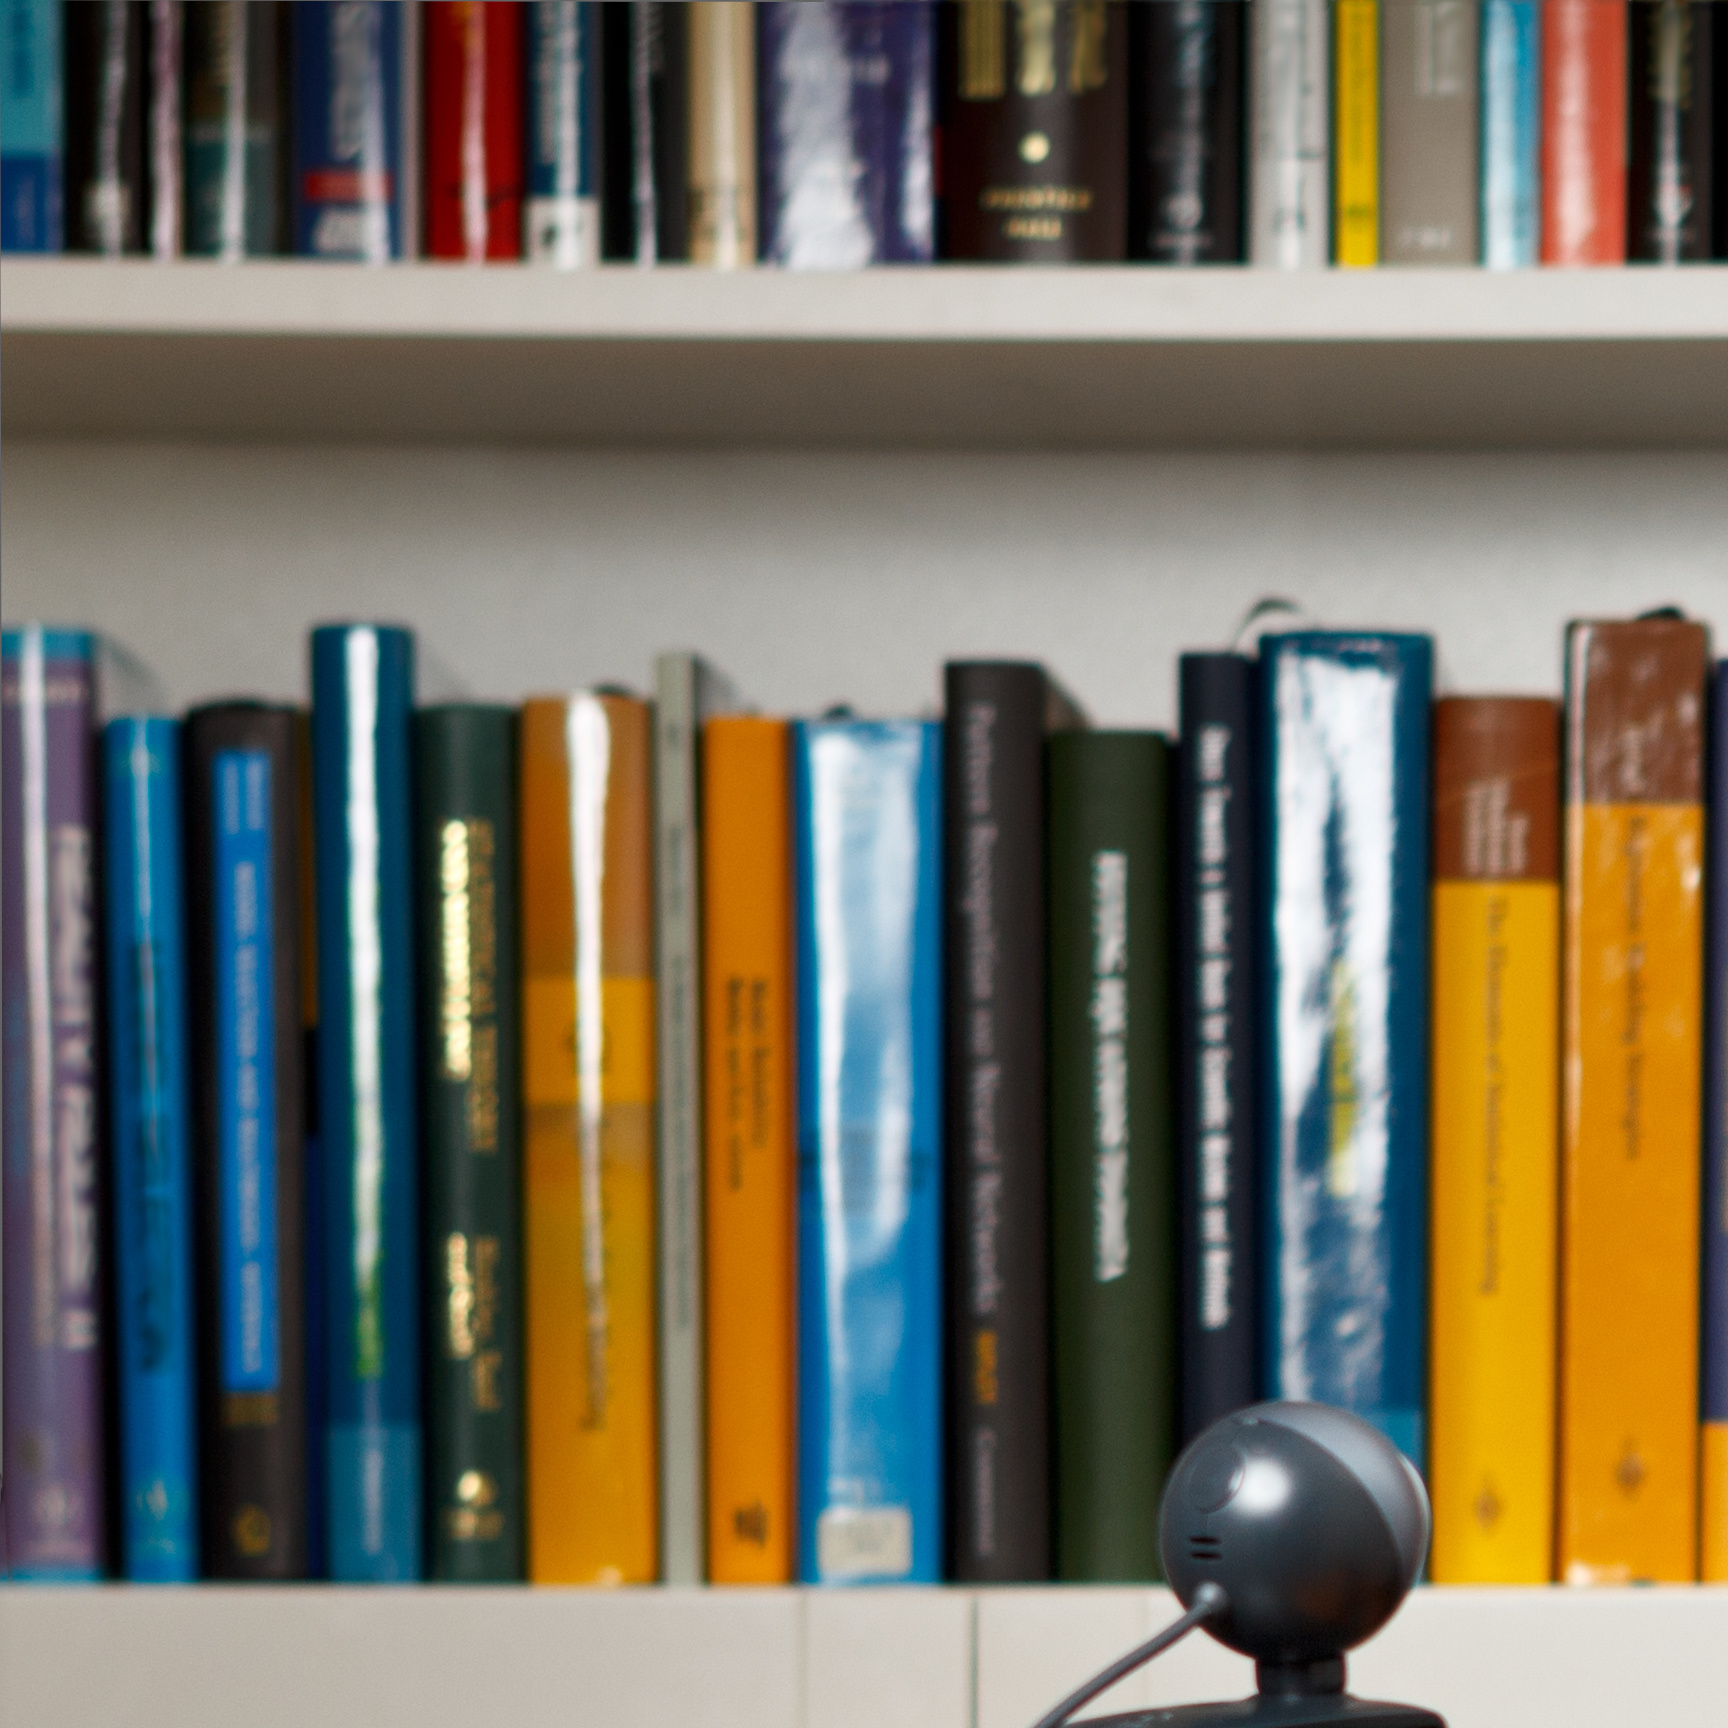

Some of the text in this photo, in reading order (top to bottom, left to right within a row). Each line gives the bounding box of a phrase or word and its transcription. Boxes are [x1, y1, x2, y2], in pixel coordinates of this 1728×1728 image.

[966, 702, 998, 816] Pattern
[54, 826, 88, 1066] REALITY
[956, 825, 998, 1002] Recognition
[969, 1064, 1002, 1163] Neural
[972, 1173, 1003, 1315] Networks
